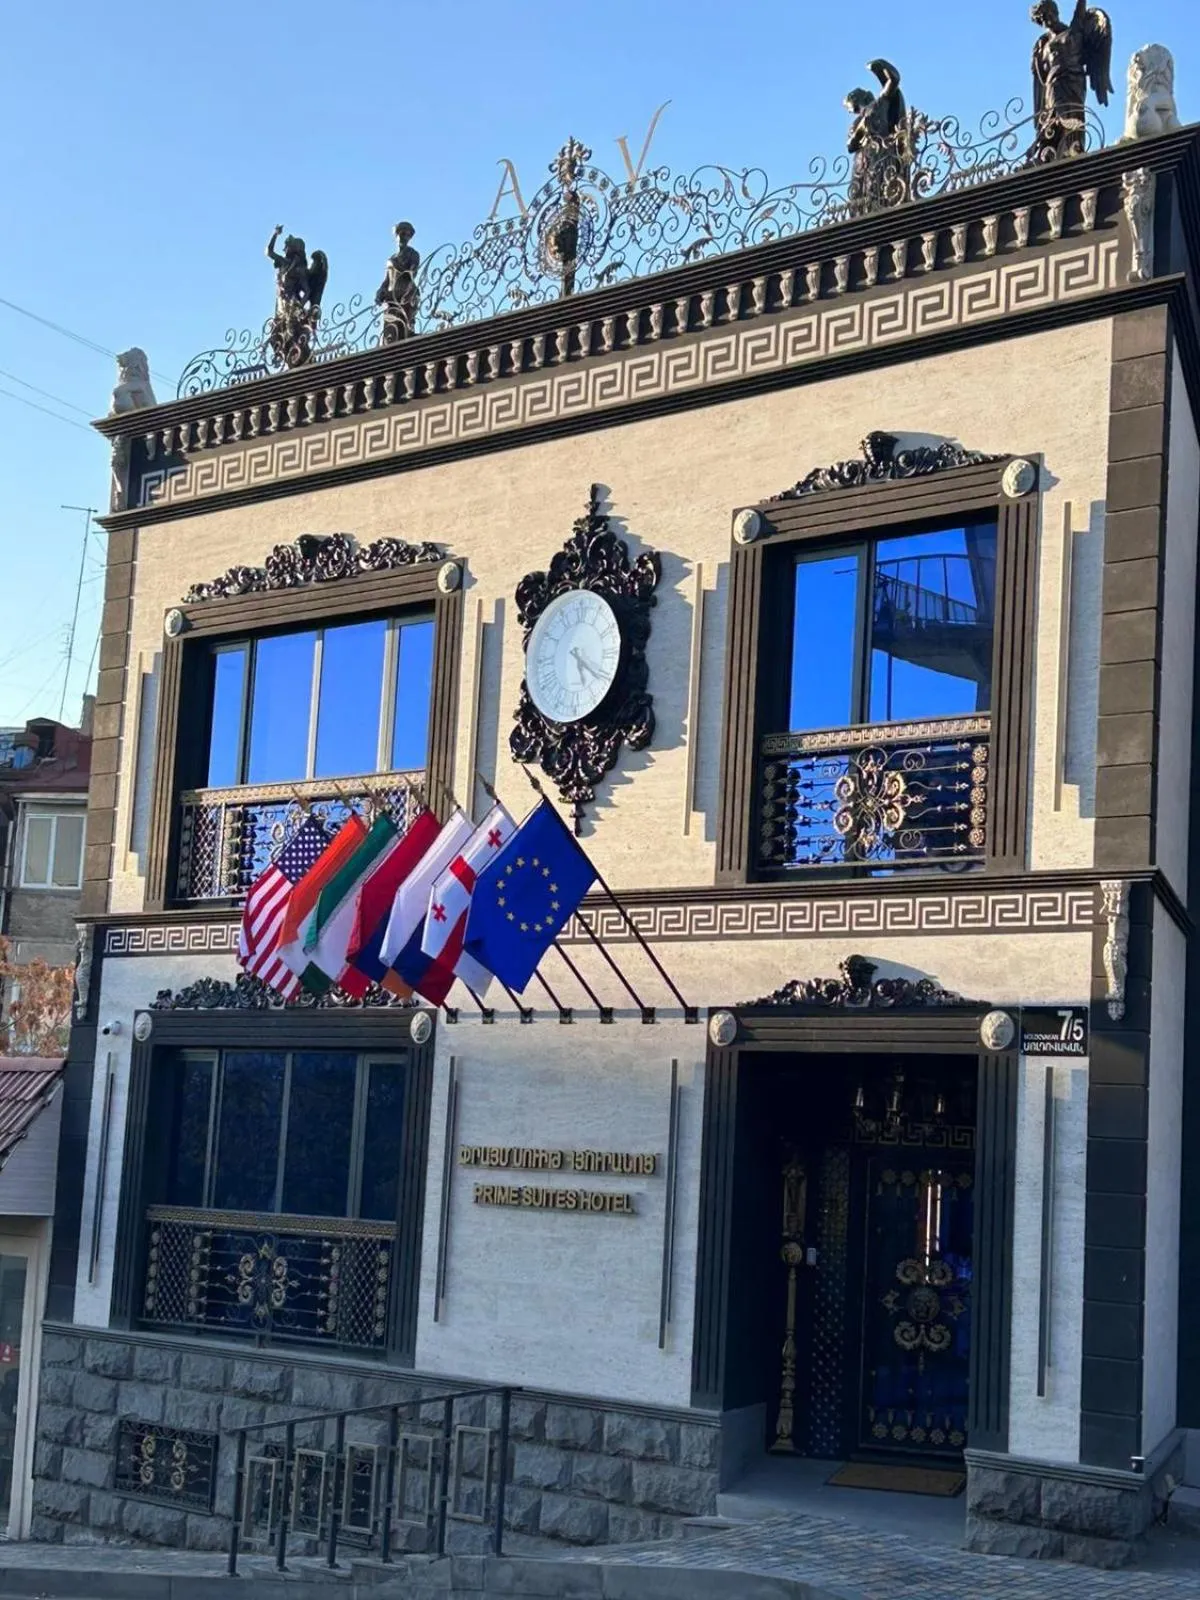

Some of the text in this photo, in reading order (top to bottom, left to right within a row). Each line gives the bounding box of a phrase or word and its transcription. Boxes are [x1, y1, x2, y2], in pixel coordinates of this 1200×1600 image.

[473, 1185, 633, 1213] PRIME SUITES HOTEL
